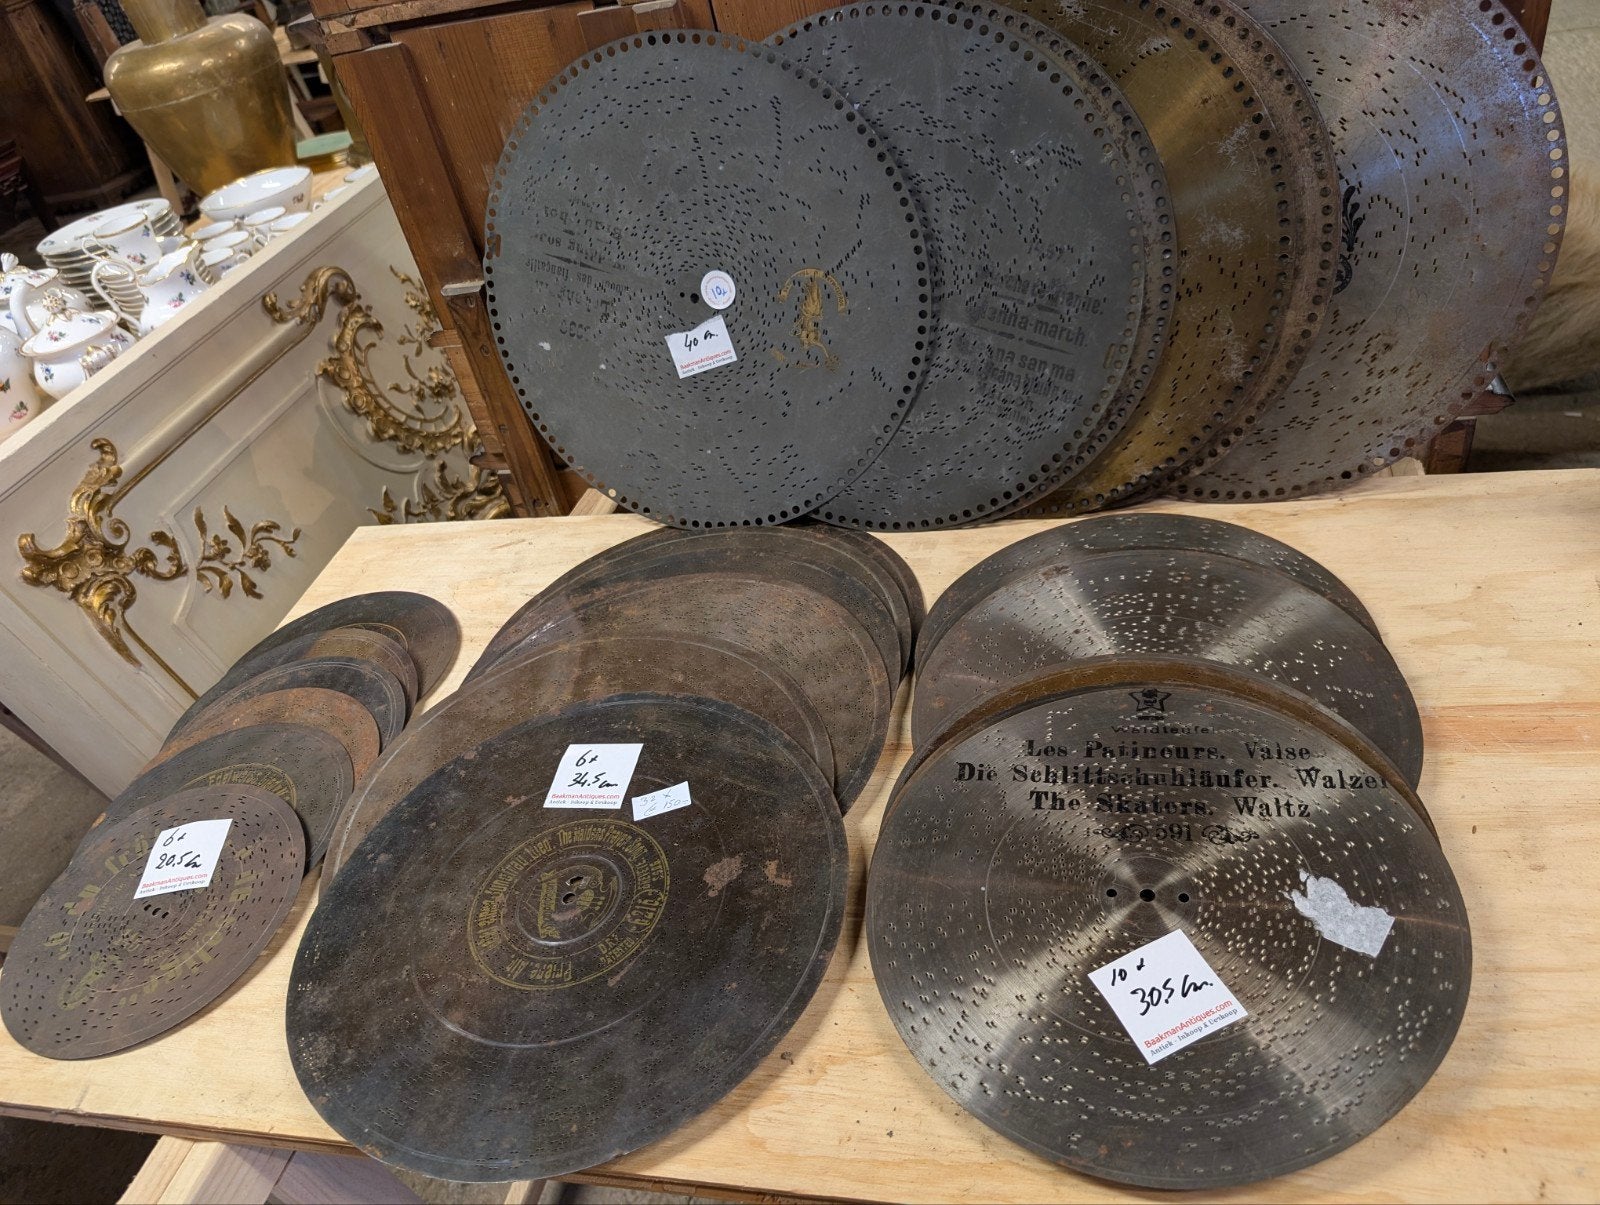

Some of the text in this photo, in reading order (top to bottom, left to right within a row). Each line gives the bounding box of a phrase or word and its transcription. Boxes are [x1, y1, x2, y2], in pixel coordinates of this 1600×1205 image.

[684, 333, 698, 351] 40
[1025, 739, 1068, 757] Les
[955, 762, 998, 782] Die
[1029, 790, 1081, 811] The
[1233, 796, 1311, 818] Waltz
[1111, 968, 1127, 987] 10
[1144, 1000, 1233, 1049] BaakmanAntiques.com
[1150, 1040, 1174, 1057] Antiek
[1177, 1024, 1203, 1043] Inkoop
